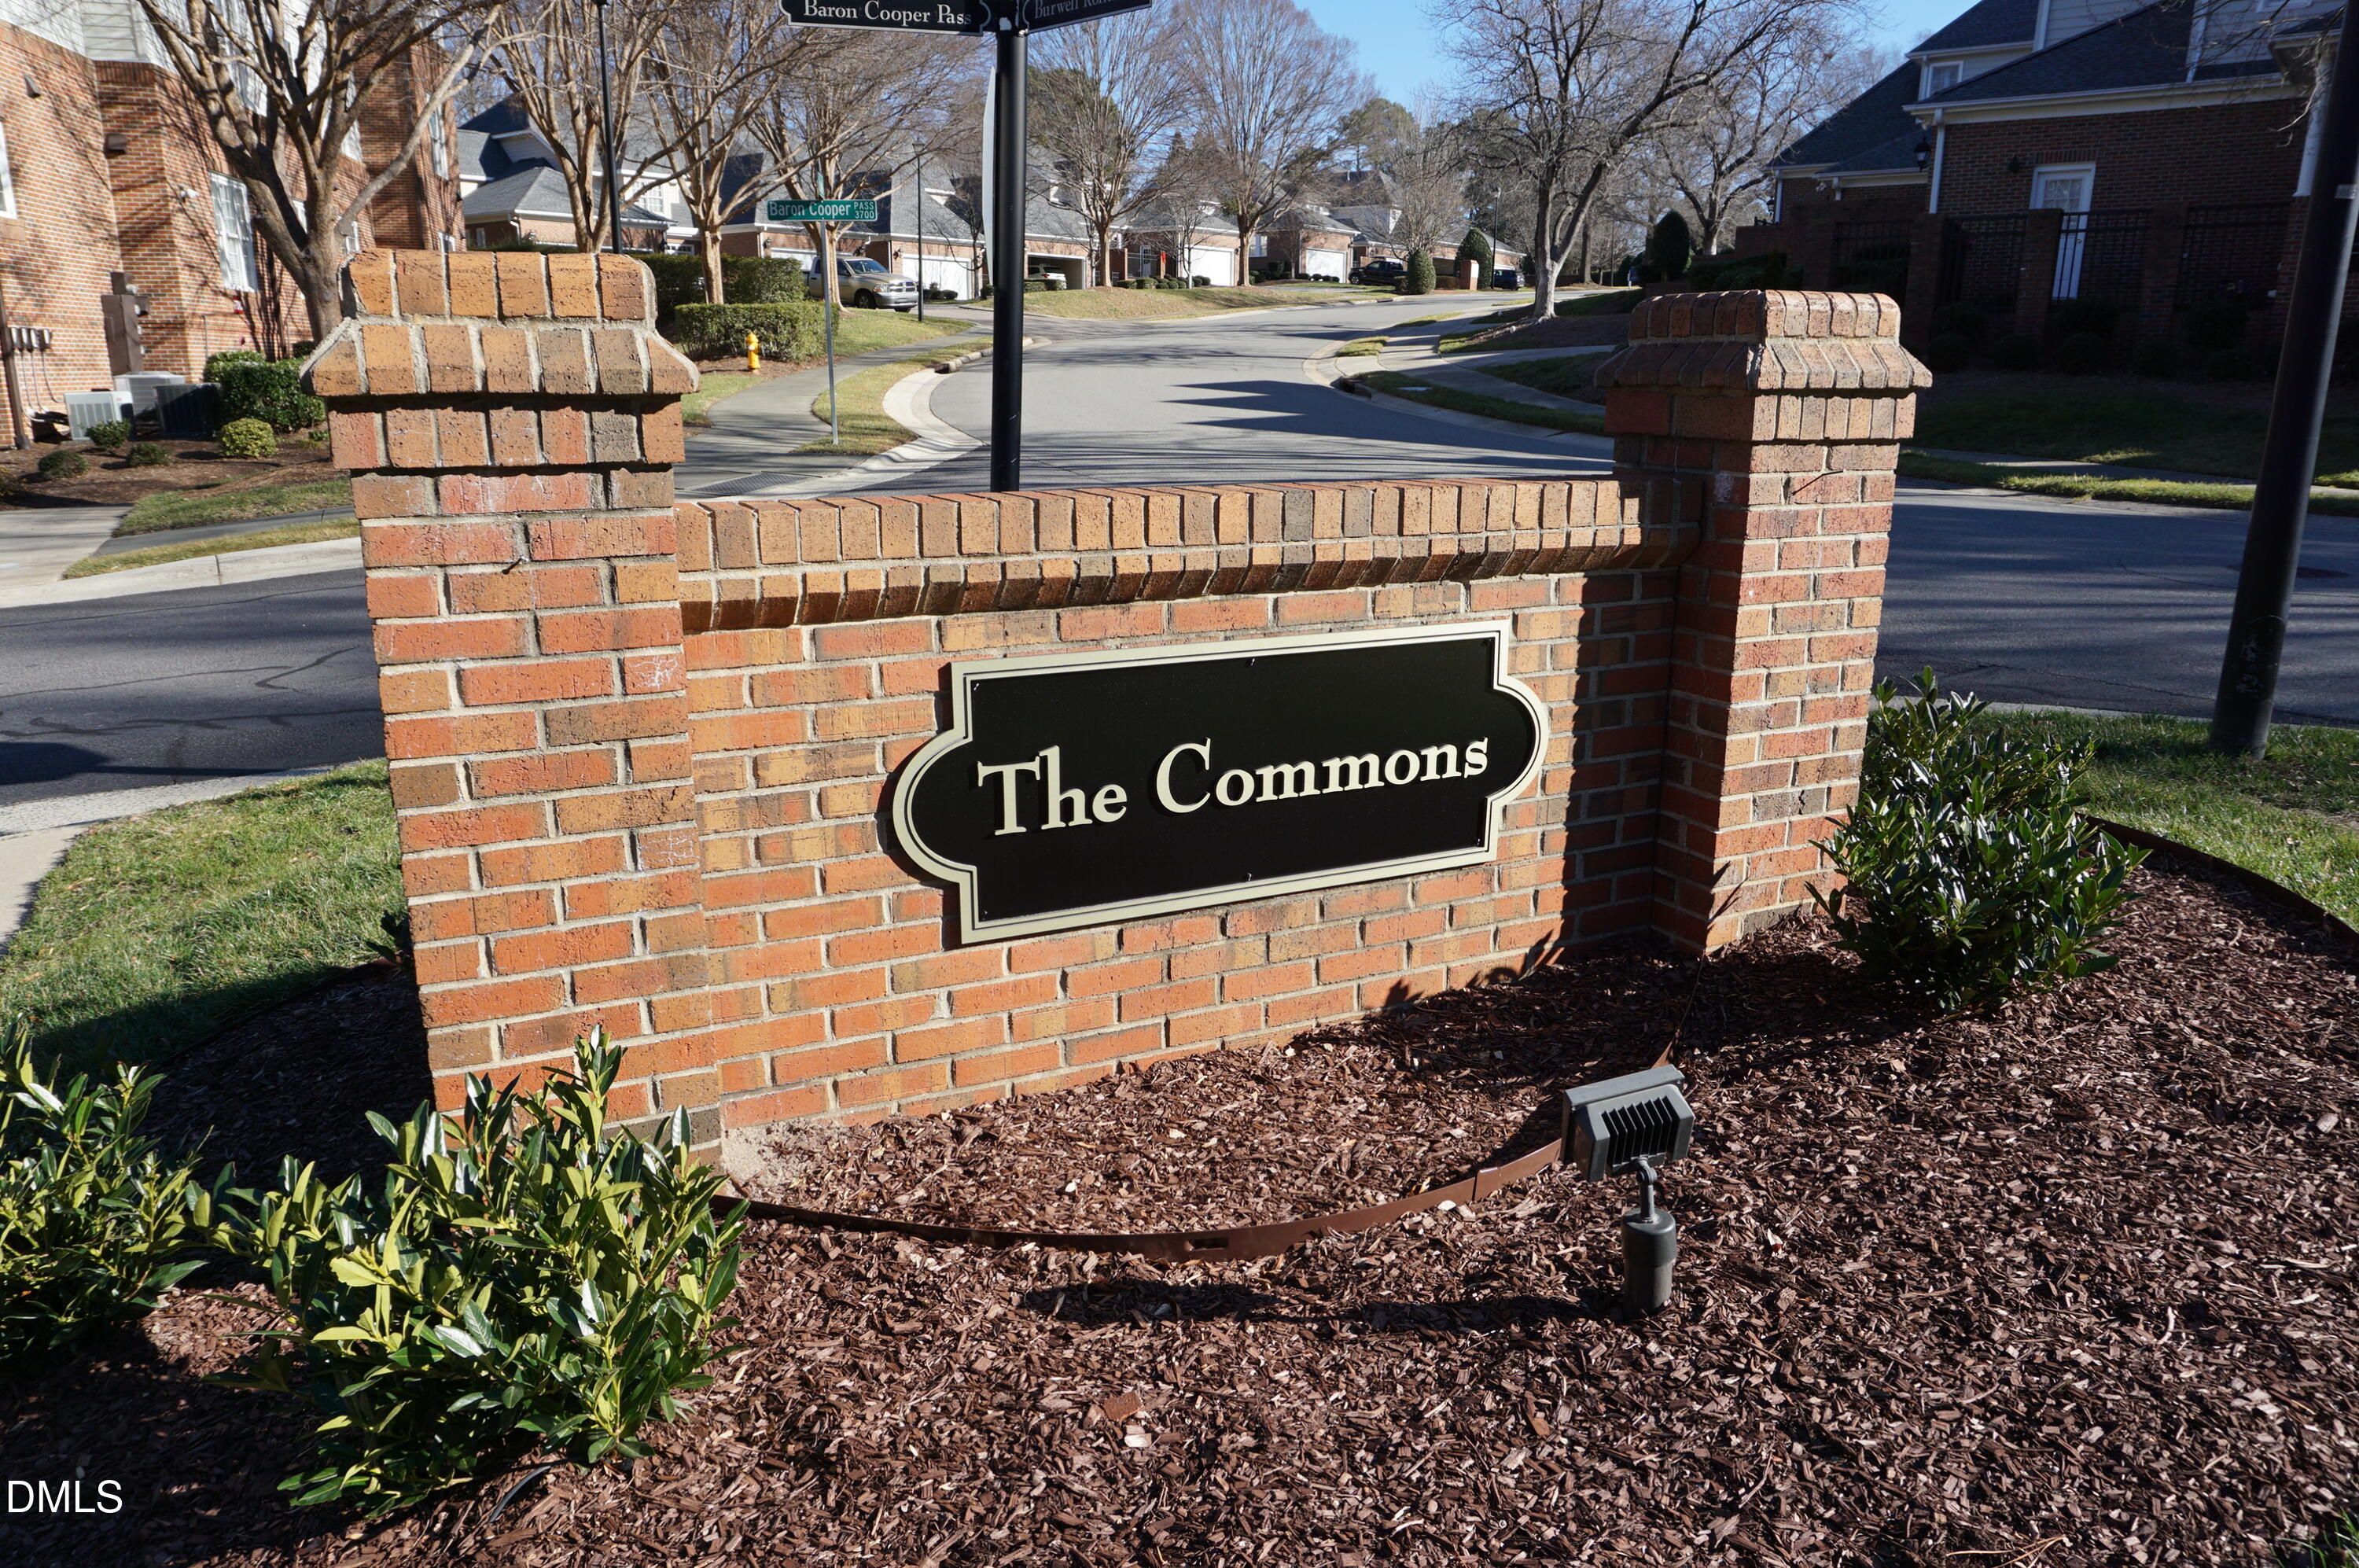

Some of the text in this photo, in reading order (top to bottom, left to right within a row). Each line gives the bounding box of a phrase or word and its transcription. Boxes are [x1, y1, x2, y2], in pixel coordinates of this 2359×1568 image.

[804, 0, 972, 27] Baron Cooper Pass
[769, 201, 852, 219] Baron Cooper
[853, 201, 874, 210] PASS
[855, 210, 874, 219] 3700
[977, 737, 1489, 836] The Commons
